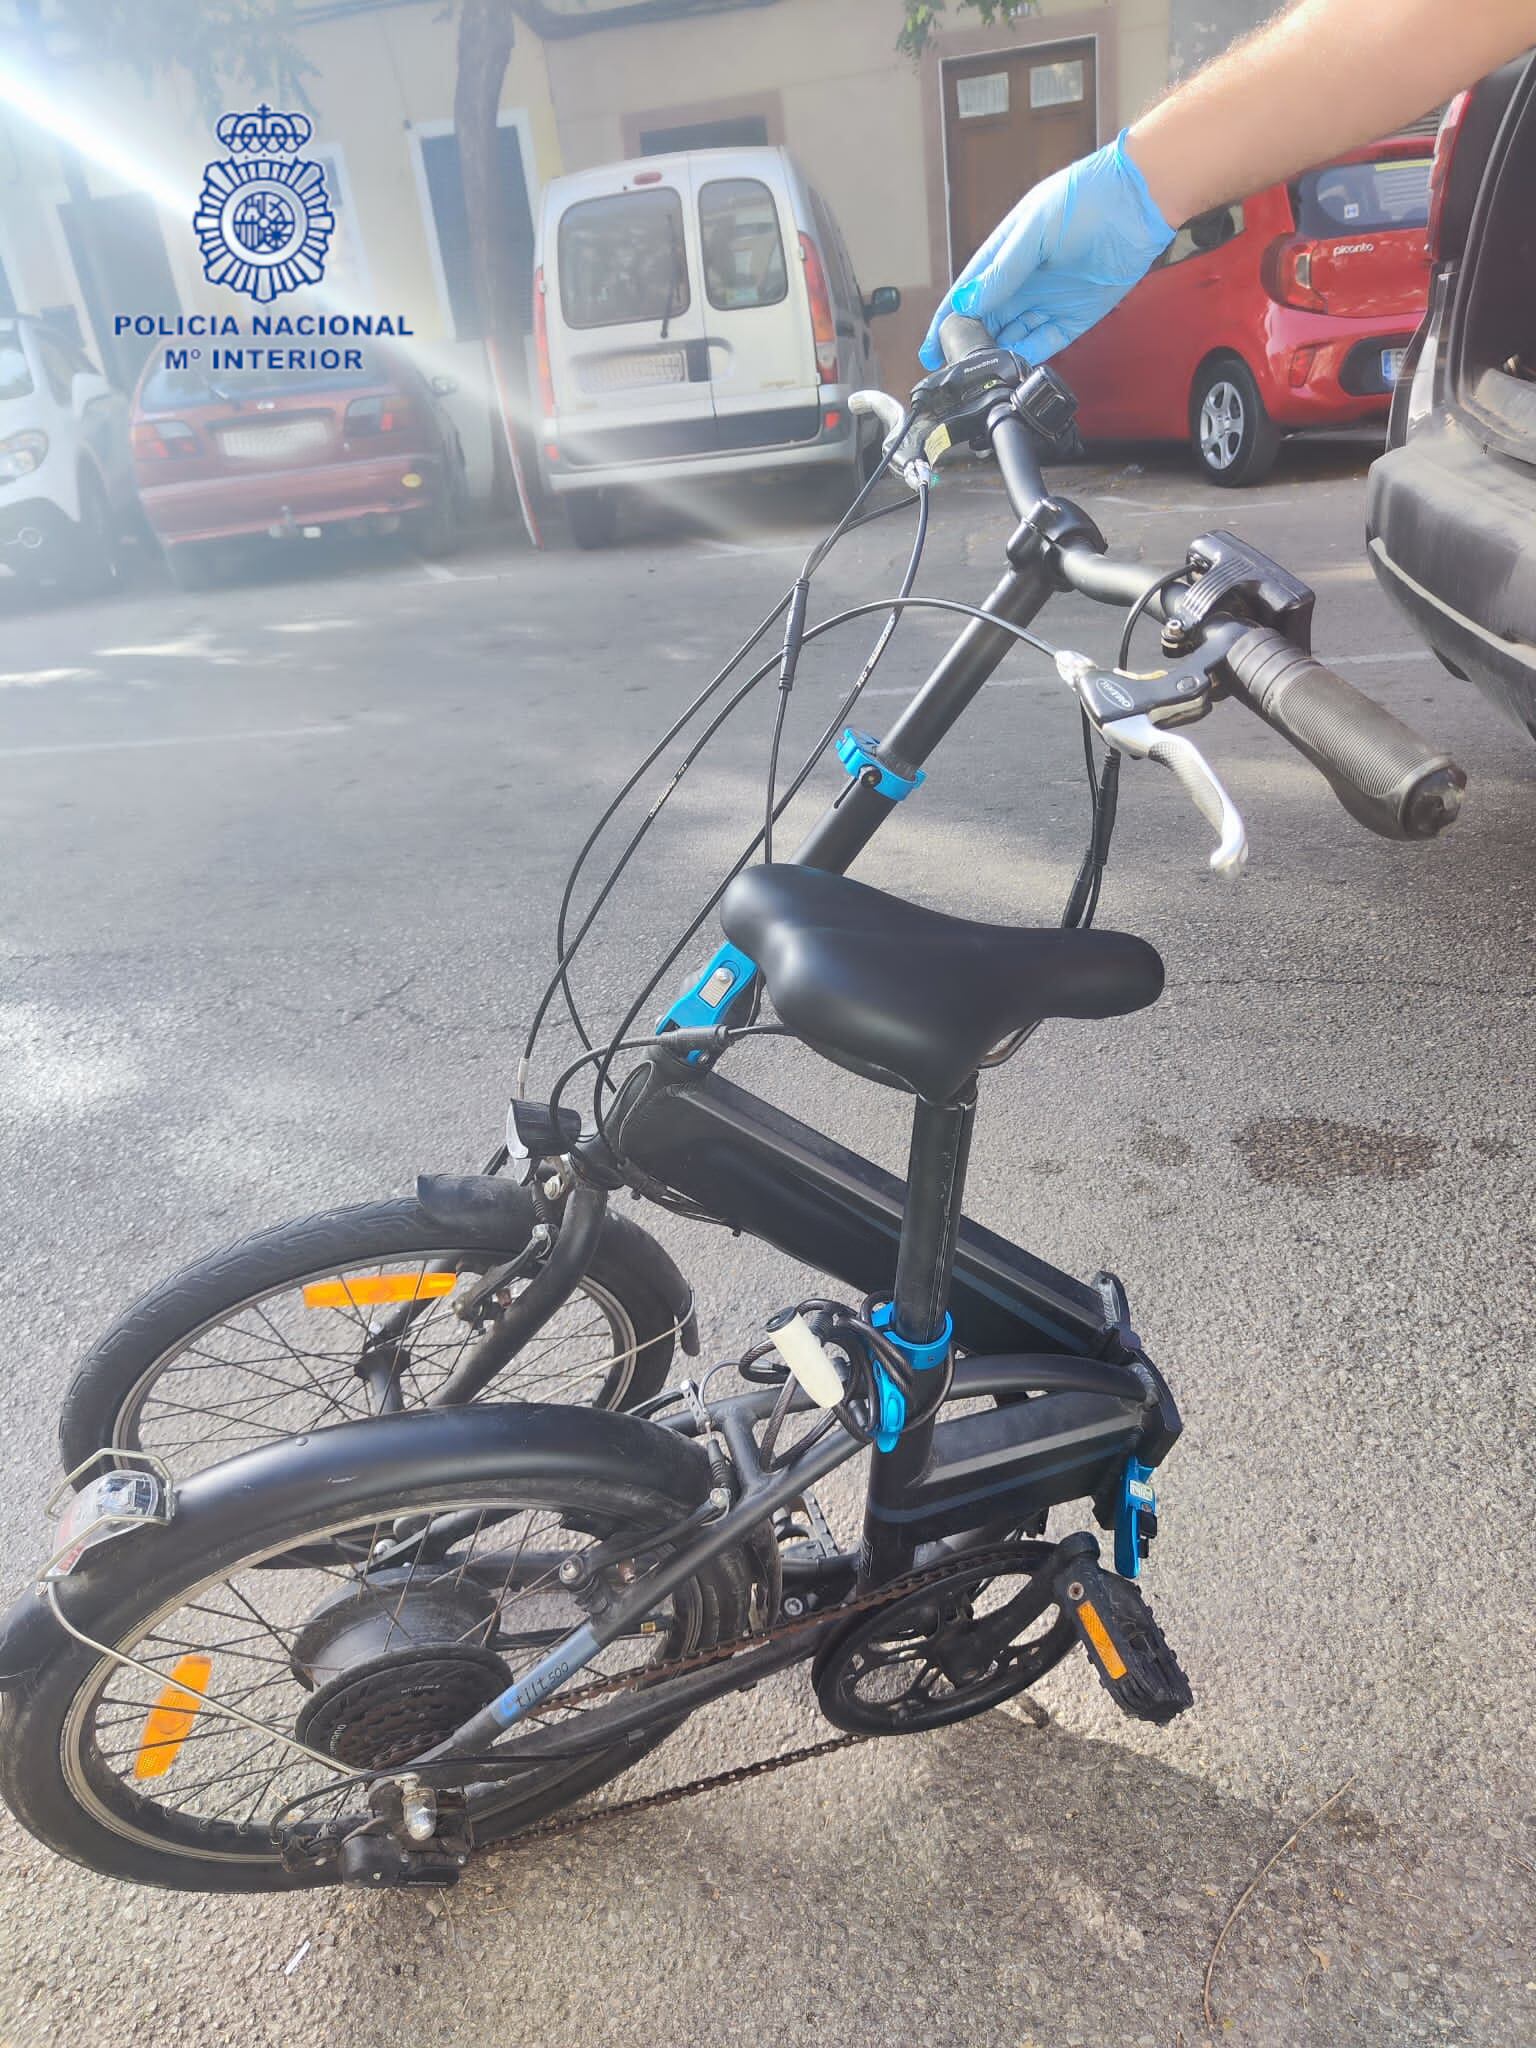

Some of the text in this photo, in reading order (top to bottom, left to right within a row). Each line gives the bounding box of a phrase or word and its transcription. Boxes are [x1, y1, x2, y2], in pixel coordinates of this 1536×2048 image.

[1332, 242, 1374, 257] picanto
[515, 1662, 569, 1709] tilt 500
